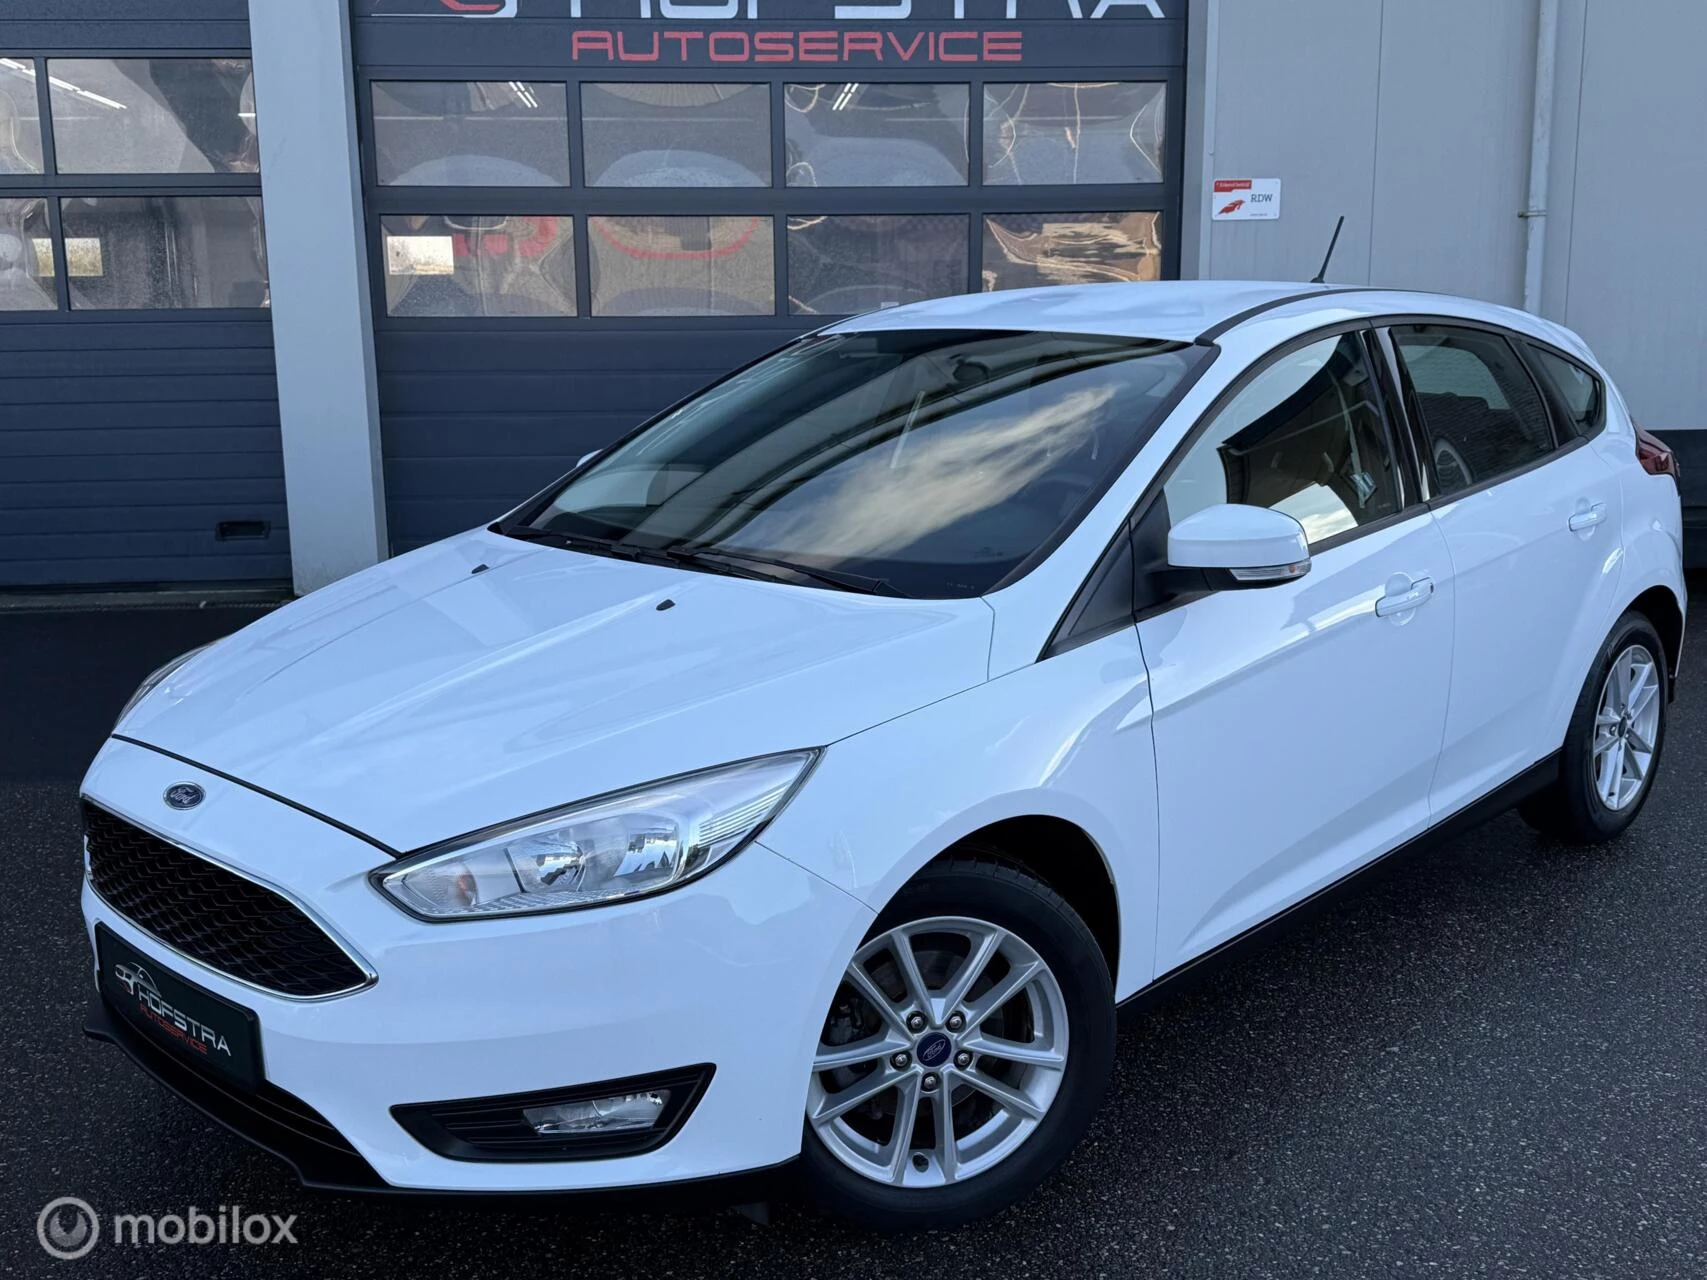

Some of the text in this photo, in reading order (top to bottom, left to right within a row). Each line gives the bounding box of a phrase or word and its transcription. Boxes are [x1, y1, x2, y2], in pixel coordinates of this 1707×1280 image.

[572, 30, 1023, 62] AUTOSERVICE
[1250, 193, 1273, 203] RDW
[138, 983, 231, 1057] HOFSTRA
[139, 1003, 208, 1055] AUTOSERVICE
